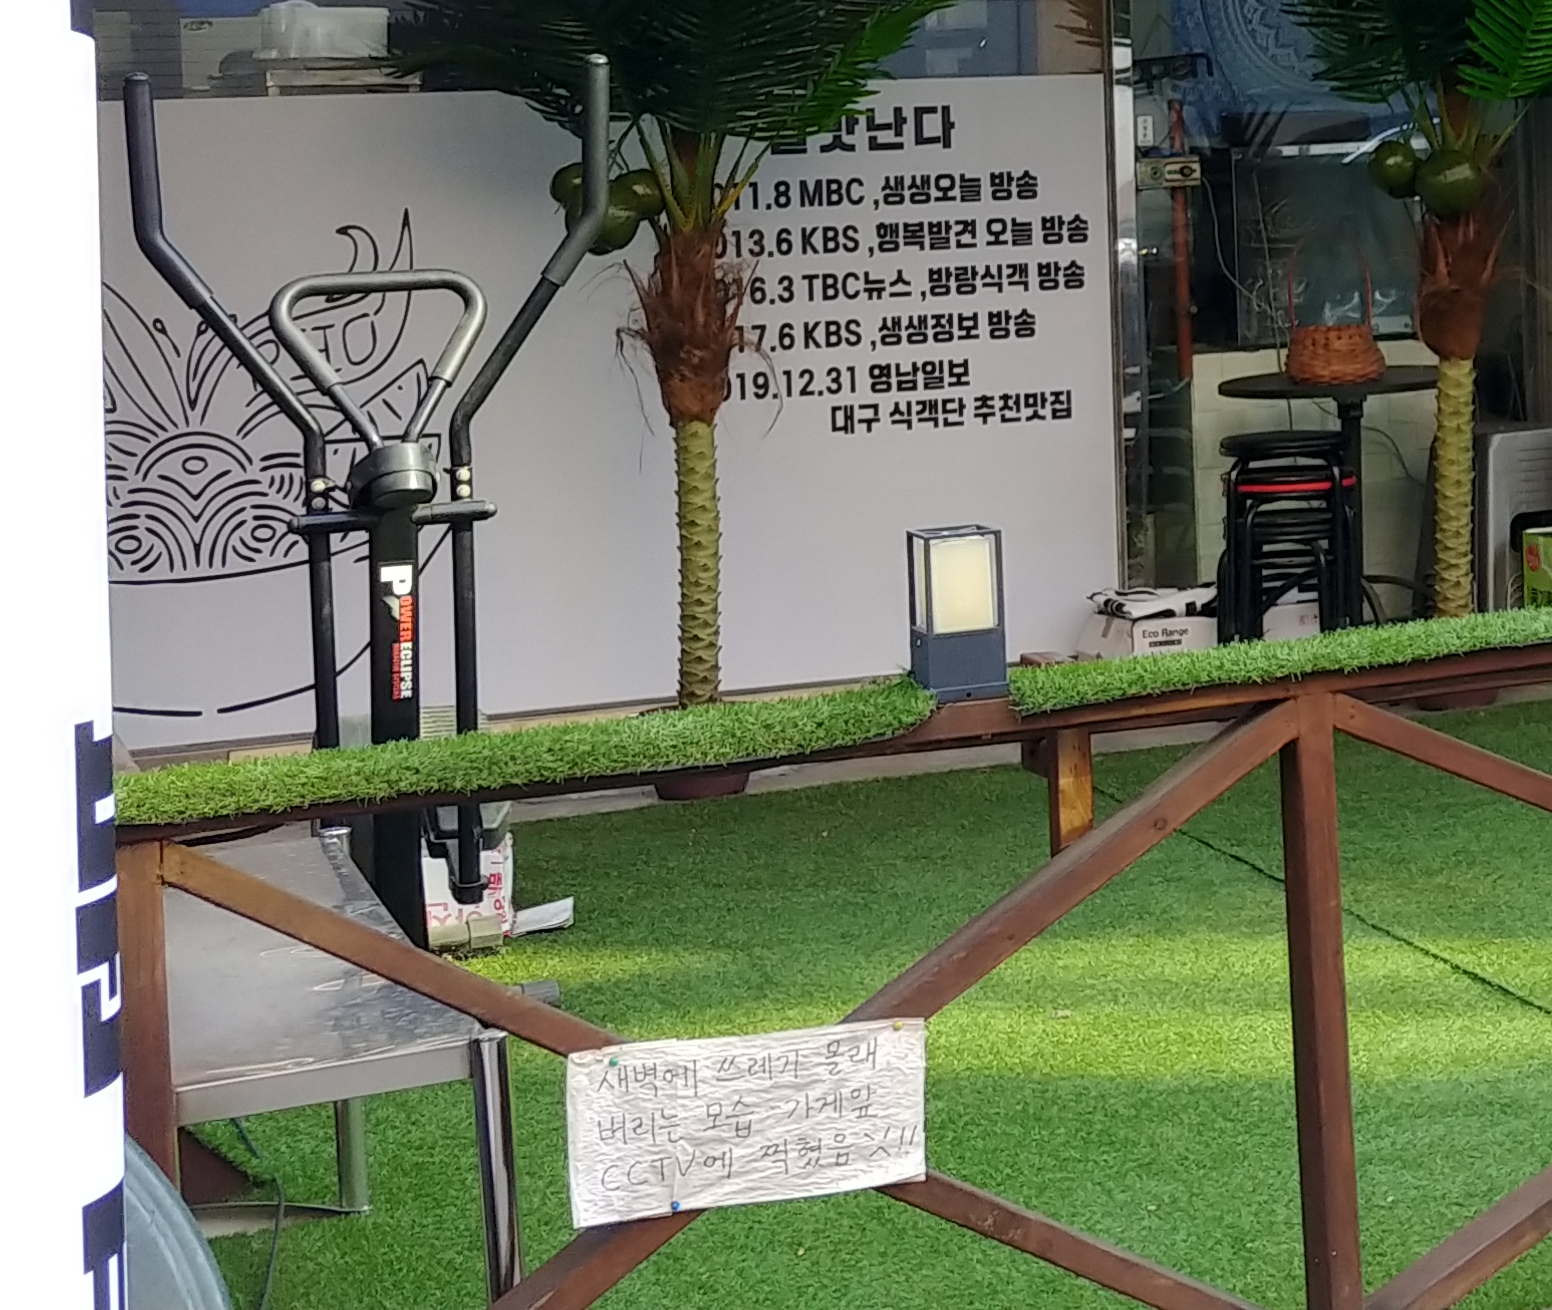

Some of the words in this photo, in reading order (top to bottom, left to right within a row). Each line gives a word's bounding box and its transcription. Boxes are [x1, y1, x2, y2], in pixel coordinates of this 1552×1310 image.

[799, 177, 865, 208] MBC
[990, 170, 1039, 200] 방송
[801, 225, 860, 255] KBS
[985, 217, 1033, 247] 오늘
[1041, 213, 1089, 245] 방송
[802, 269, 912, 303] TBC뉴스
[1037, 260, 1085, 290] 방송
[803, 319, 862, 350] KBS
[987, 308, 1037, 338] 방송
[869, 359, 970, 394] 영남일보
[831, 404, 880, 434] 대구
[889, 398, 965, 431] 식객단
[973, 390, 1073, 426] 추천맛집
[1142, 629, 1159, 639] Eco
[1161, 627, 1190, 638] Range
[597, 1059, 698, 1098] 새벽에
[716, 1050, 800, 1082] 쓰레기
[825, 1037, 878, 1077] 몰래
[598, 1108, 685, 1146] 버리는
[702, 1095, 755, 1139] 모습
[602, 1146, 734, 1192] CCTV에
